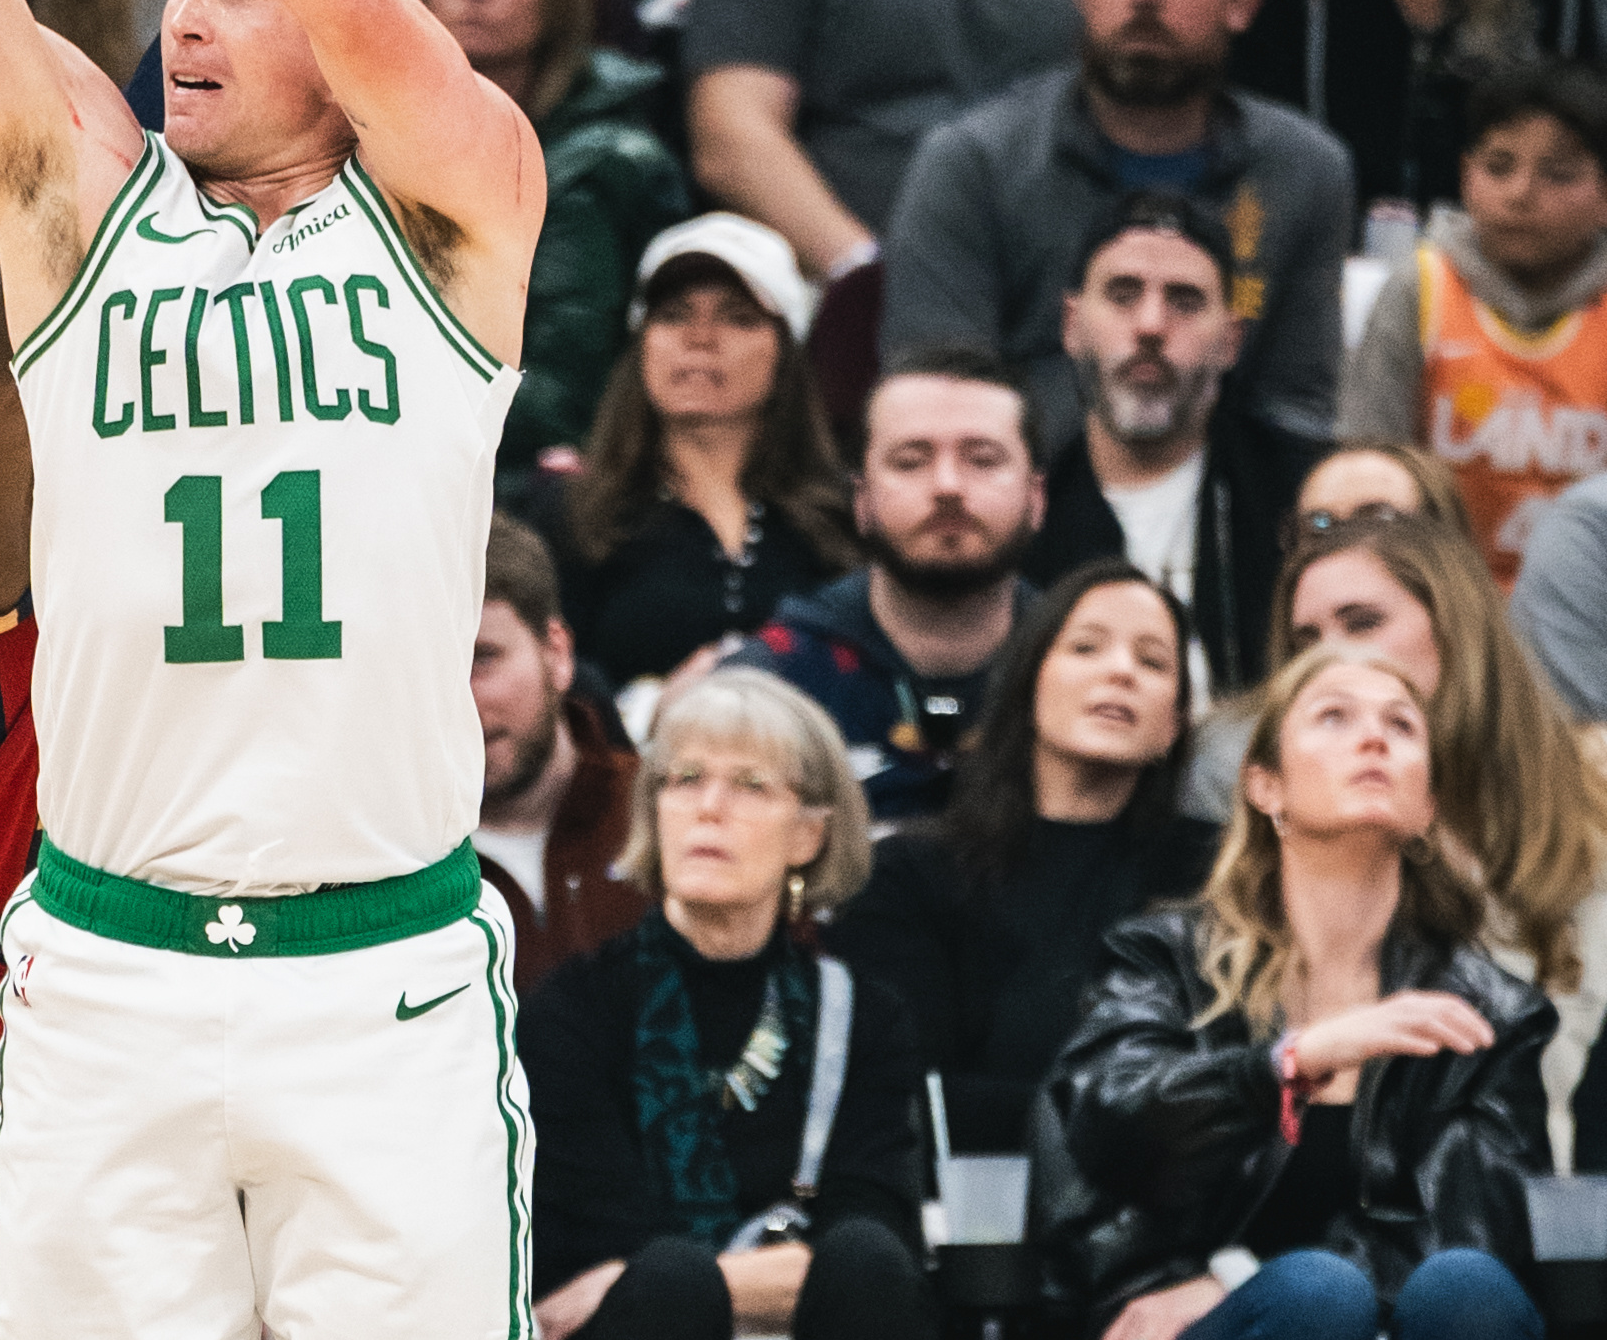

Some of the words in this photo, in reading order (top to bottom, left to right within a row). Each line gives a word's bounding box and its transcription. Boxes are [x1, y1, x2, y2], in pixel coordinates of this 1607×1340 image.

[272, 202, 351, 254] Amica
[92, 274, 401, 439] CELTICS
[164, 469, 342, 664] 11
